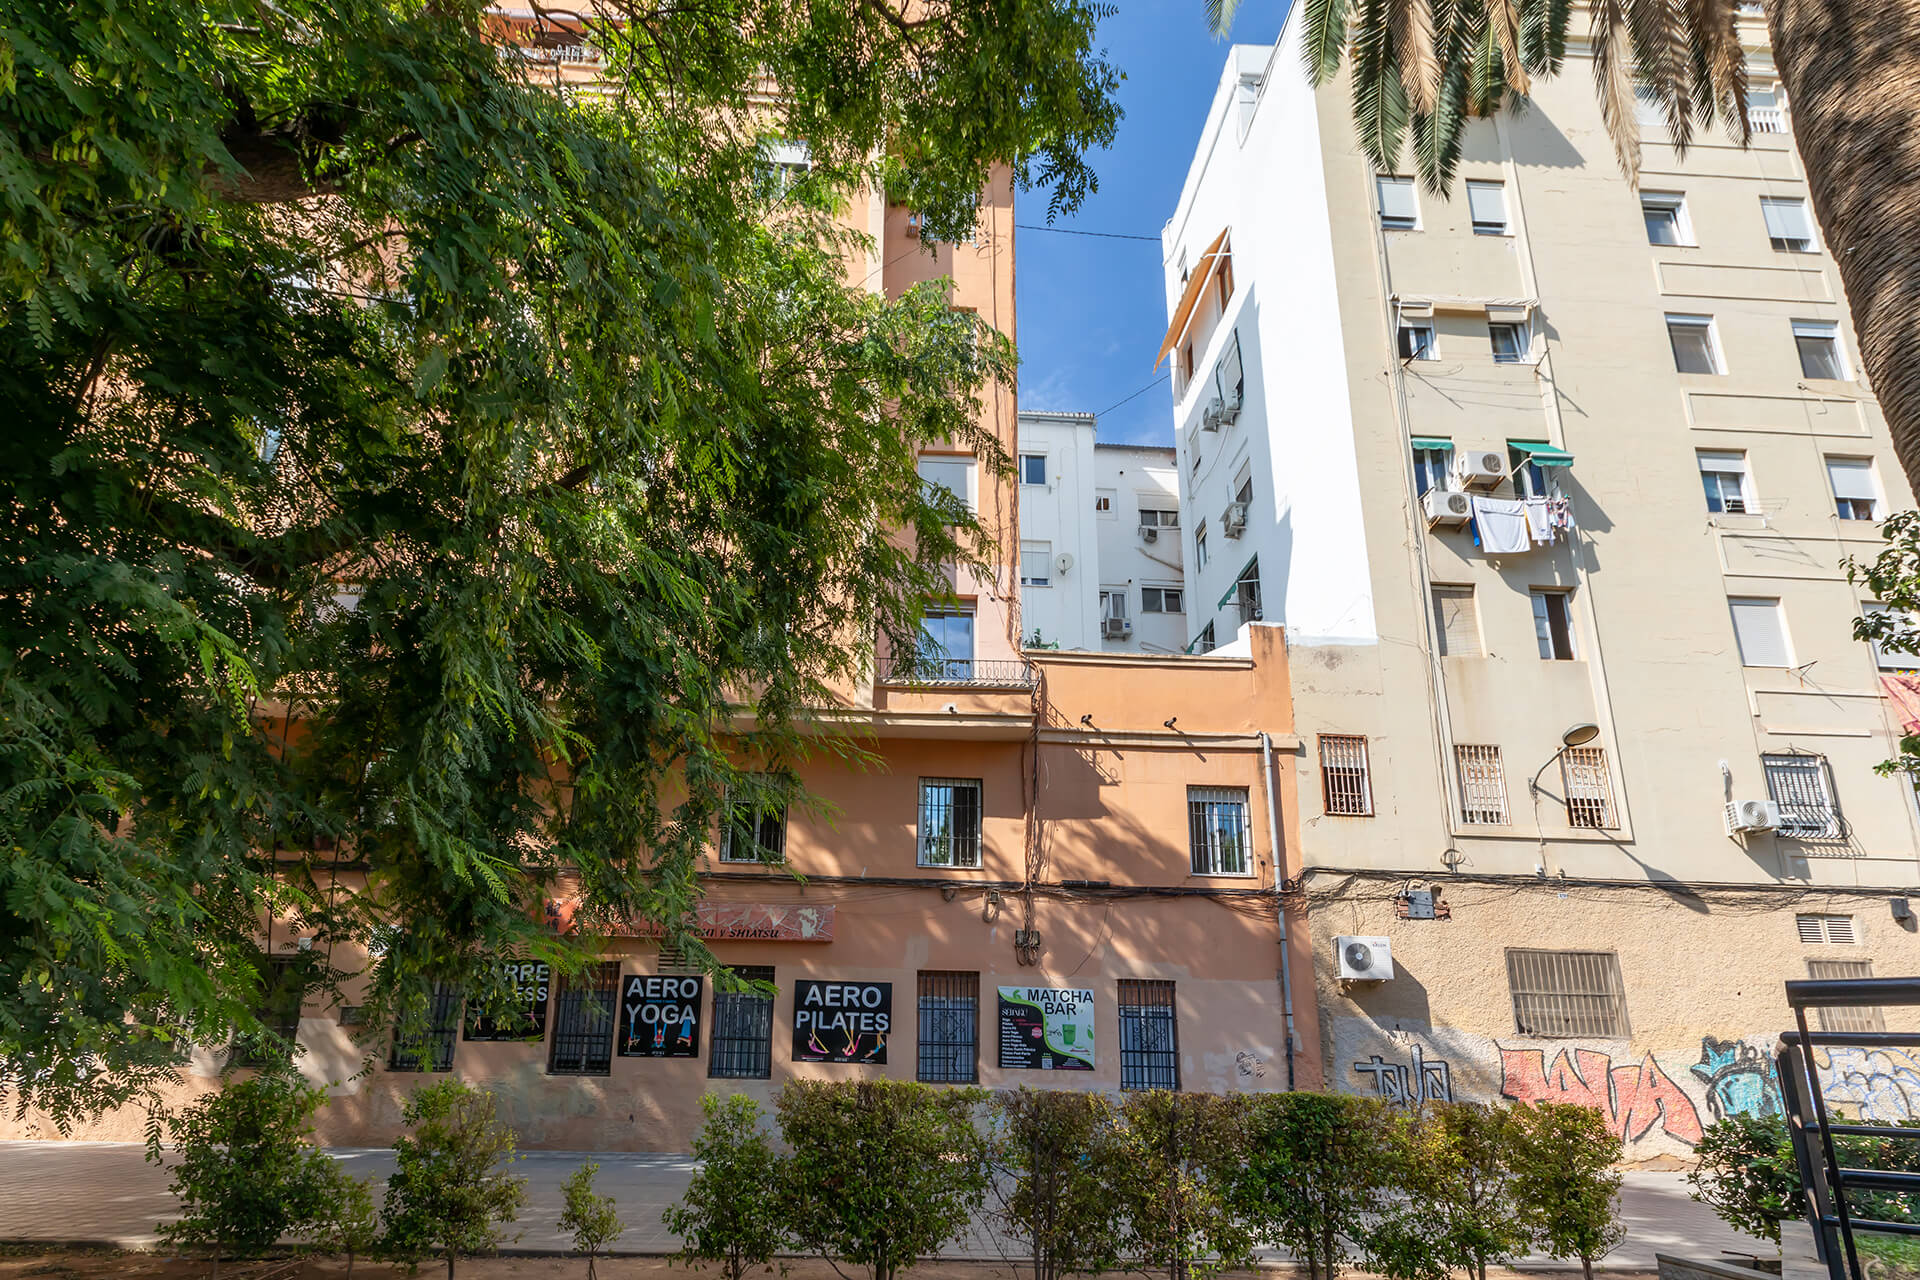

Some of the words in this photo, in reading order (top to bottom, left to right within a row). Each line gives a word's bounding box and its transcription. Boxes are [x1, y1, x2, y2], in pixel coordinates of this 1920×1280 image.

[729, 928, 779, 938] SHIATSU
[626, 977, 699, 999] AERO
[804, 984, 882, 1009] AERO
[1027, 989, 1094, 1003] MATCHA
[625, 1003, 697, 1025] YOGA
[1044, 1002, 1077, 1016] BAR
[796, 1010, 889, 1031] PILATES
